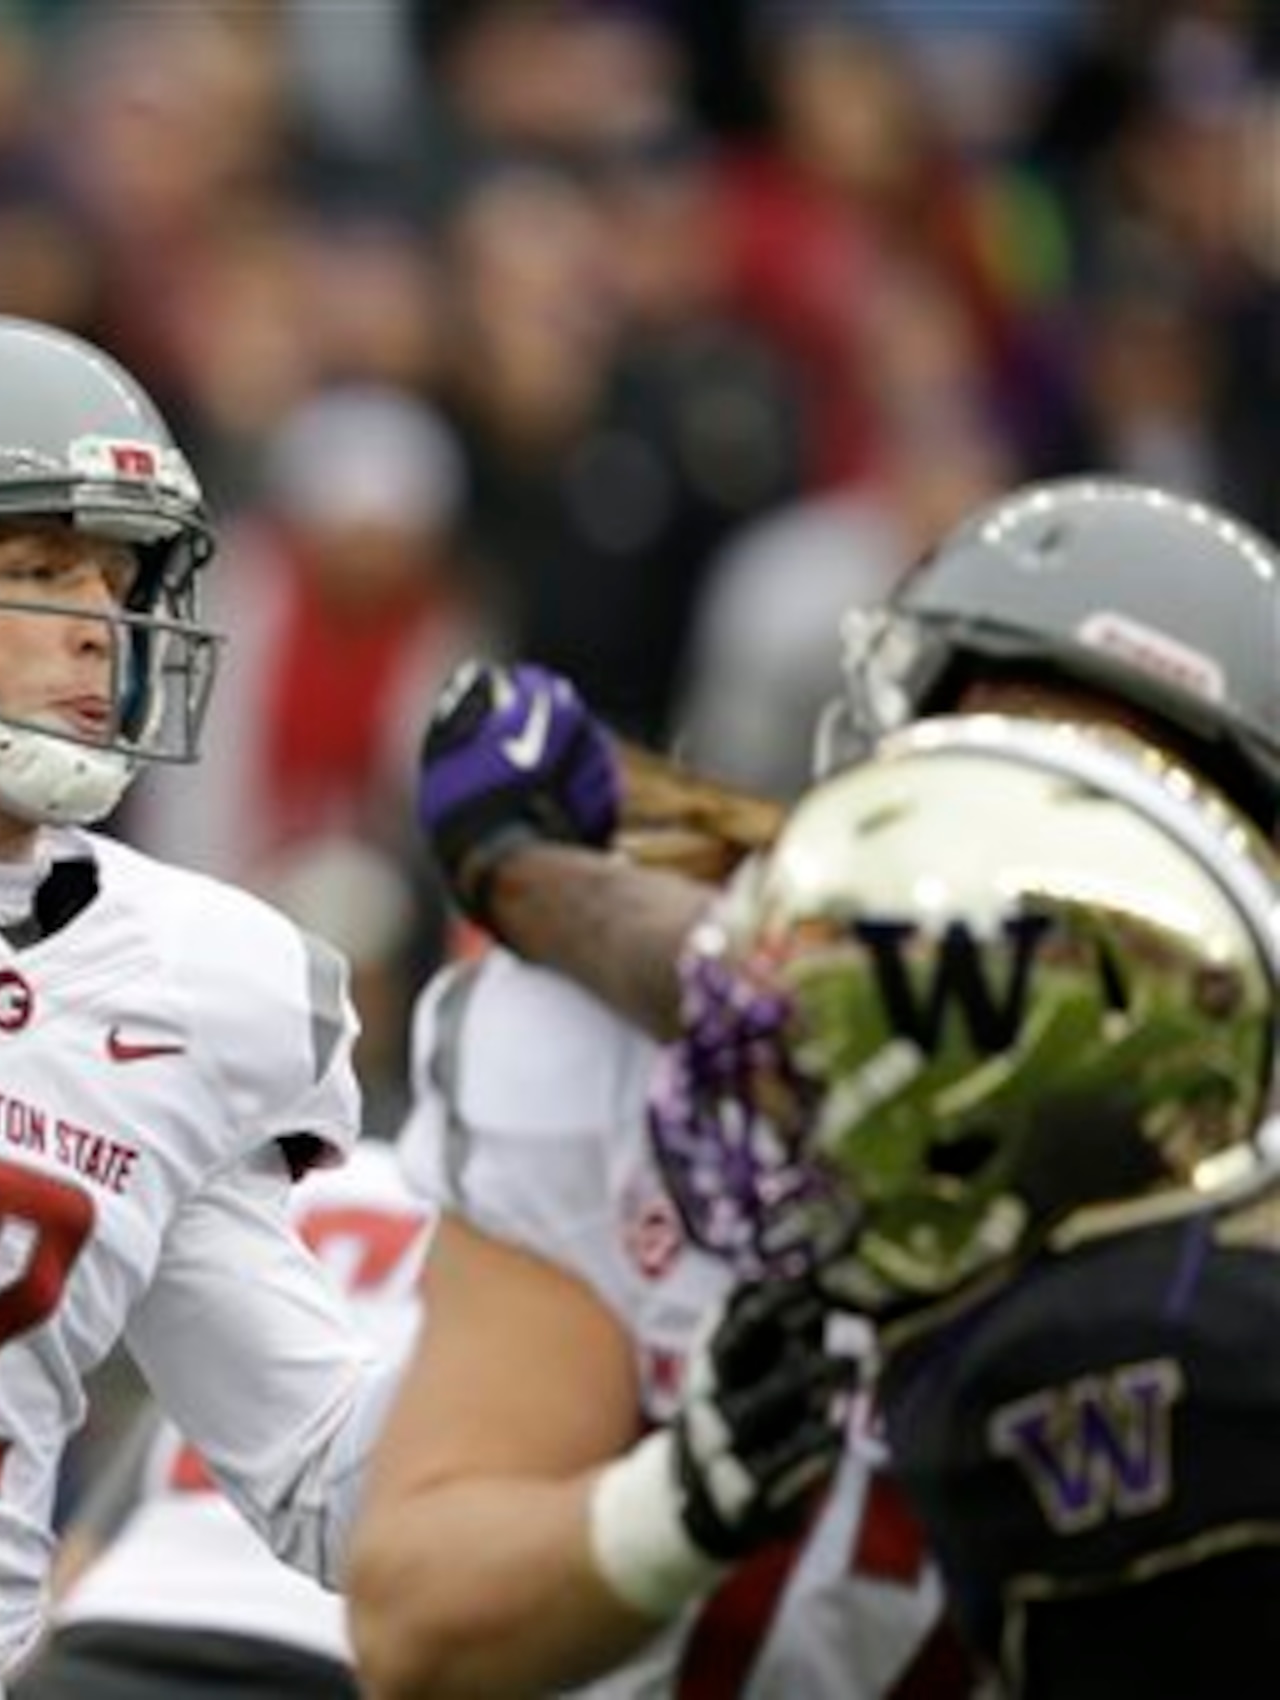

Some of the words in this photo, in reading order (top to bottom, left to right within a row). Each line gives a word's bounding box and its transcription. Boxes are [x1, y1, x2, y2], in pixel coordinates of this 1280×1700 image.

[852, 912, 1052, 1057] W
[55, 1119, 141, 1195] STATE
[988, 1355, 1186, 1537] W
